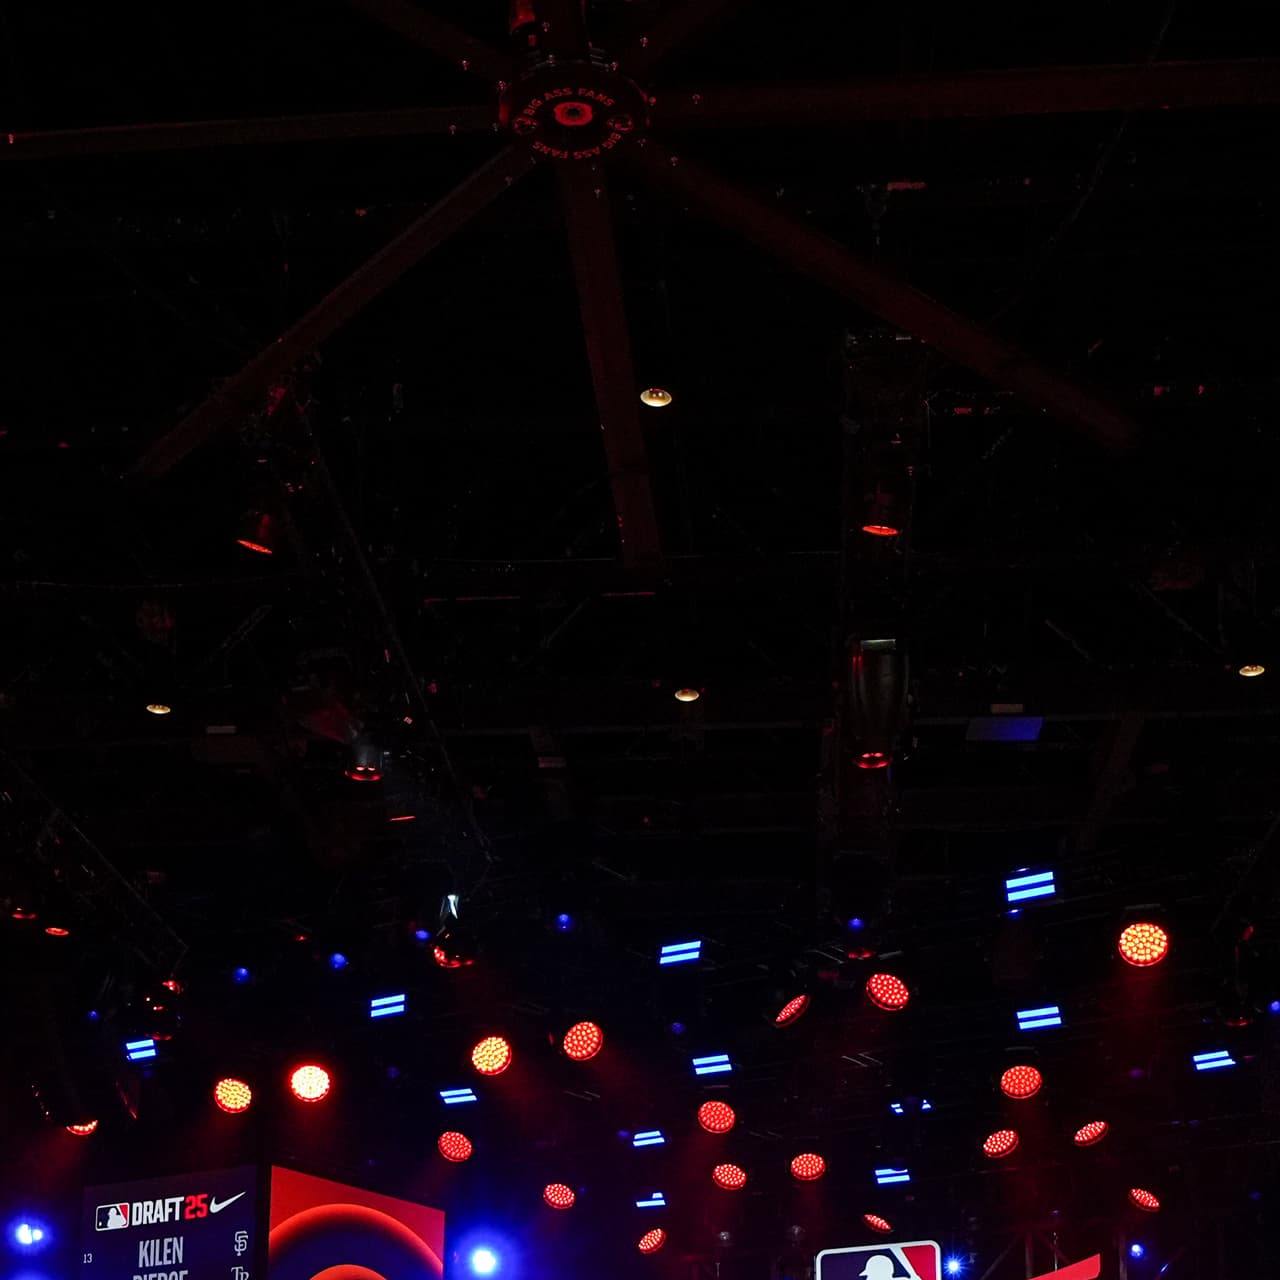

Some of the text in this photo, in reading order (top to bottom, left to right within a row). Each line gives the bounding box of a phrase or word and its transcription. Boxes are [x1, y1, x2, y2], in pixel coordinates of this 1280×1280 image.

[131, 1193, 208, 1226] DRAFT 25
[83, 1253, 93, 1263] 13
[139, 1237, 183, 1267] KILEN
